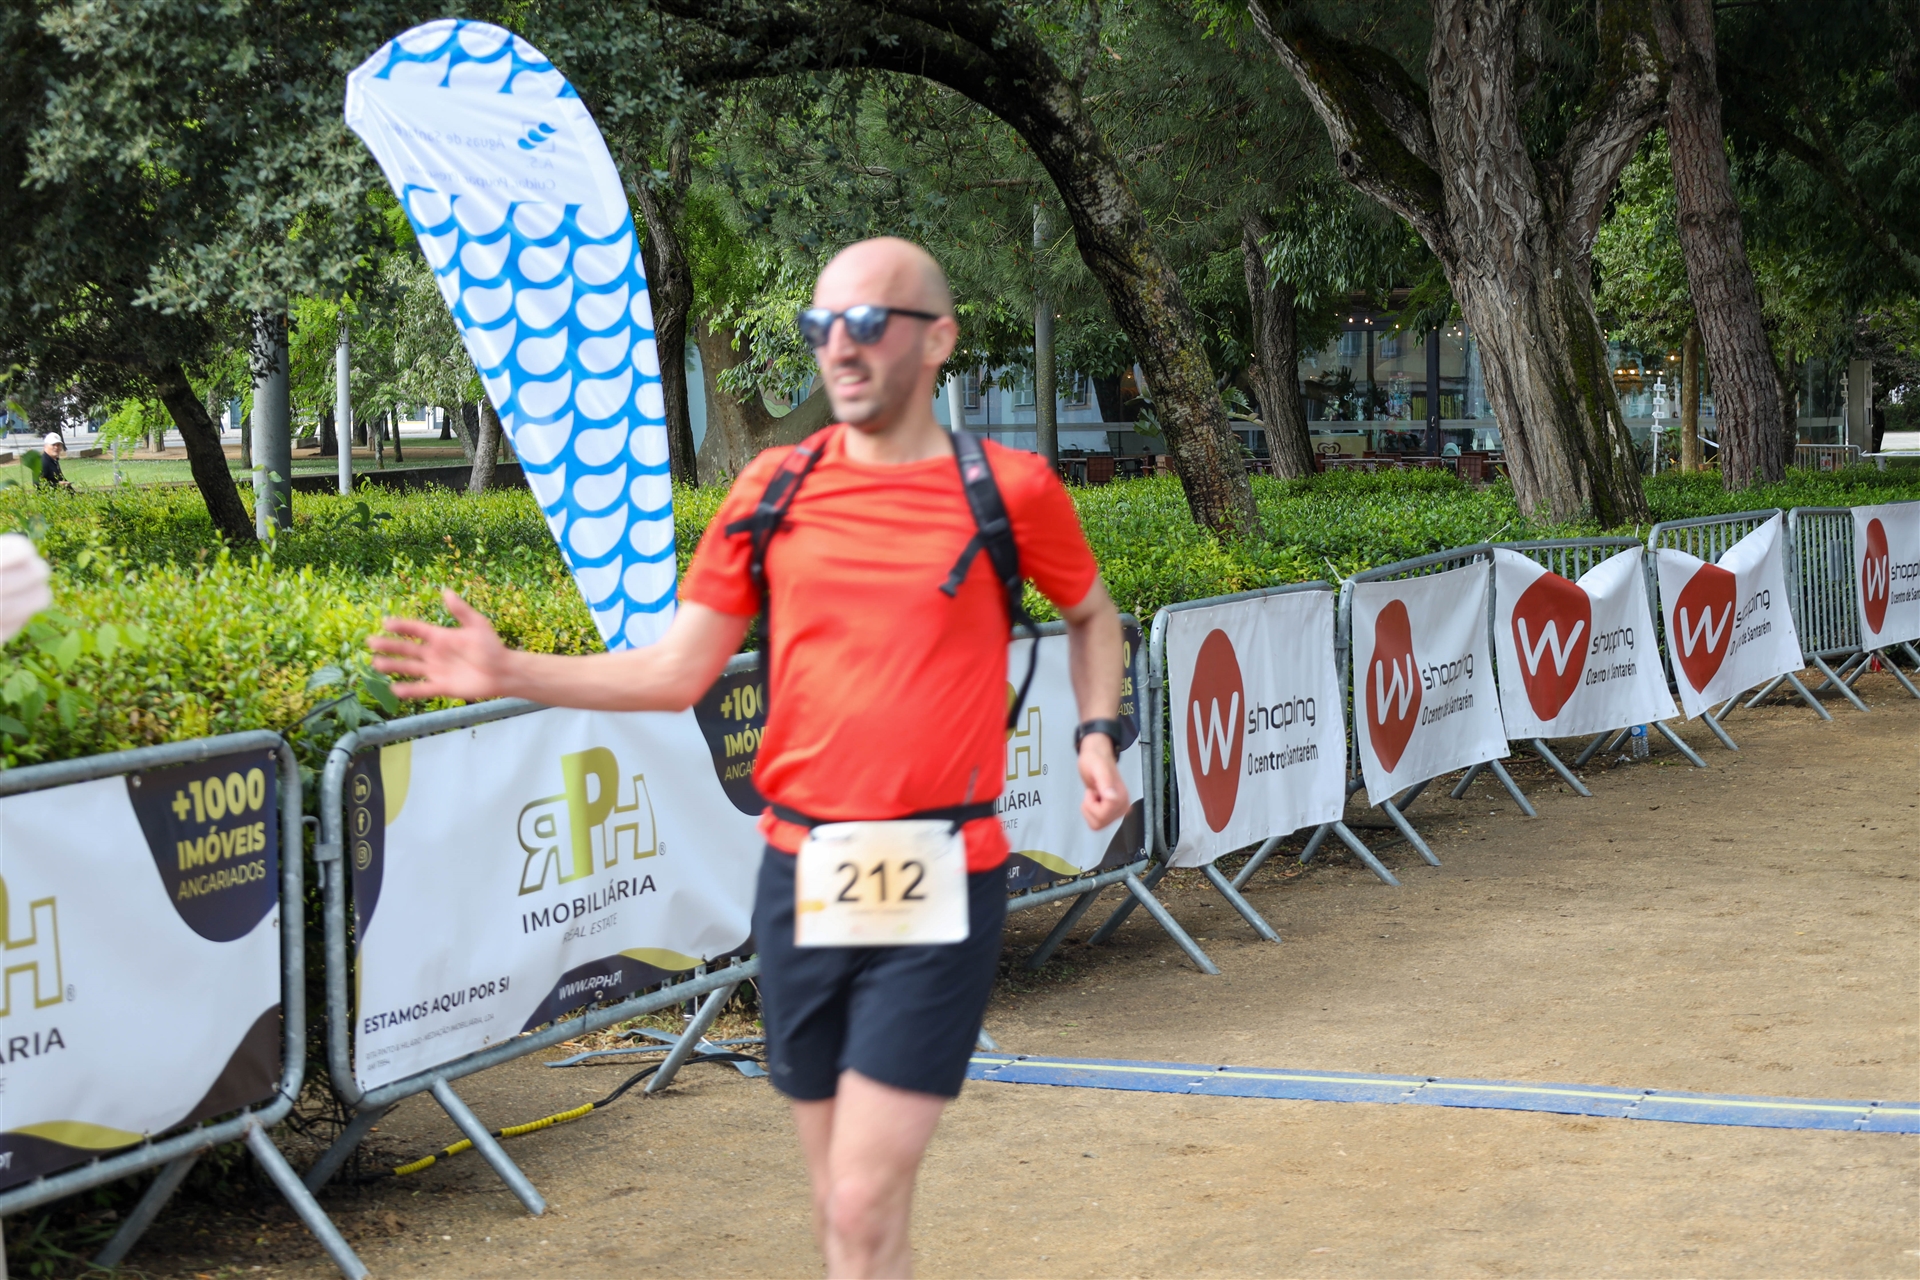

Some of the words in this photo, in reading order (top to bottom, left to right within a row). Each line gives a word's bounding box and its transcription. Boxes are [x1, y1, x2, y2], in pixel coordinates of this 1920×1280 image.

[171, 767, 266, 823] +1000
[177, 822, 267, 871] IMÓVEIS
[177, 859, 267, 902] ANGARIADOS
[836, 860, 928, 903] 212
[522, 874, 658, 934] IMOBILIÁRIA
[562, 925, 588, 945] REAL
[590, 913, 619, 935] ESTATE
[364, 1001, 429, 1034] ESTAMOS
[431, 990, 466, 1014] AQUI
[469, 980, 497, 1003] POR
[499, 976, 510, 994] SI
[558, 970, 622, 1001] WWW.RPH.PT
